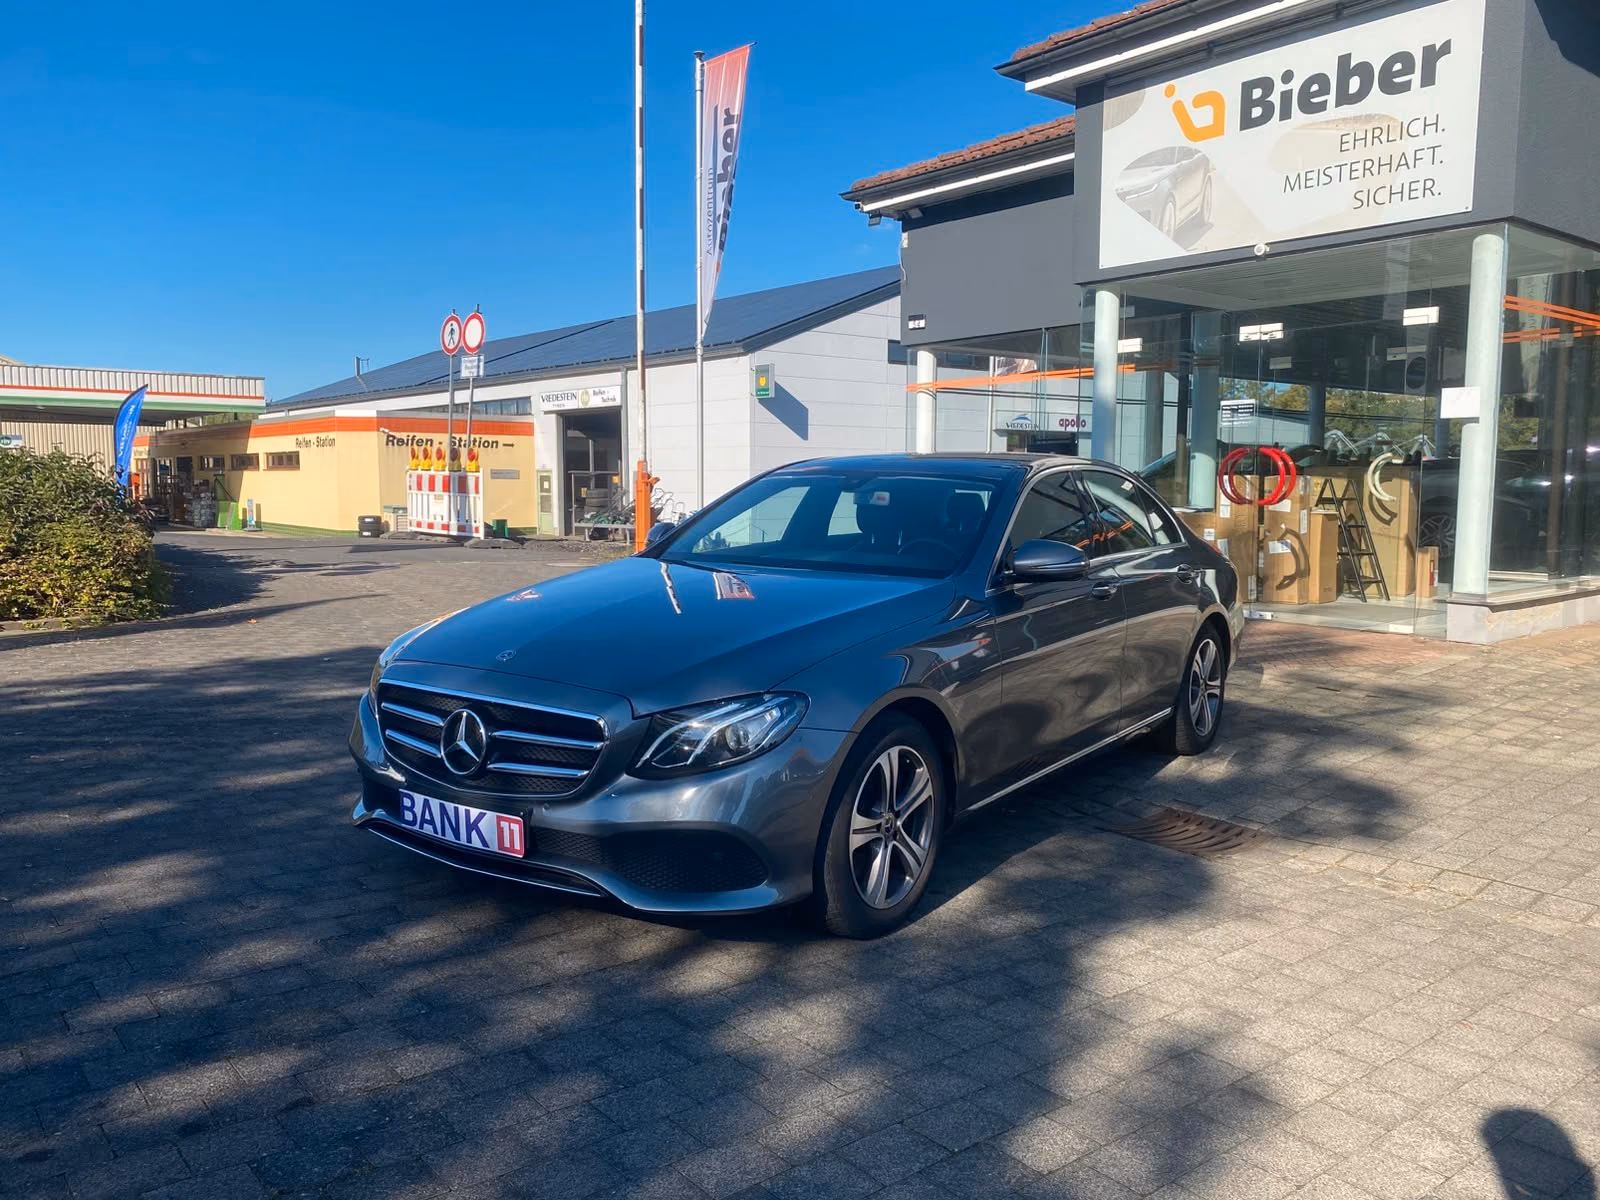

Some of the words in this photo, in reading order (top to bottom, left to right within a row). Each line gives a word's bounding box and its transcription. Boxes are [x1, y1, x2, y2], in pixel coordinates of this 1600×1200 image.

[1239, 39, 1451, 132] Bieber
[1340, 114, 1446, 153] EHRLICH.
[1283, 145, 1443, 193] MEISTERHAFT.
[1353, 178, 1442, 210] SICHER.
[385, 434, 434, 447] Reifen
[400, 792, 491, 849] BANK
[500, 820, 521, 850] 11
